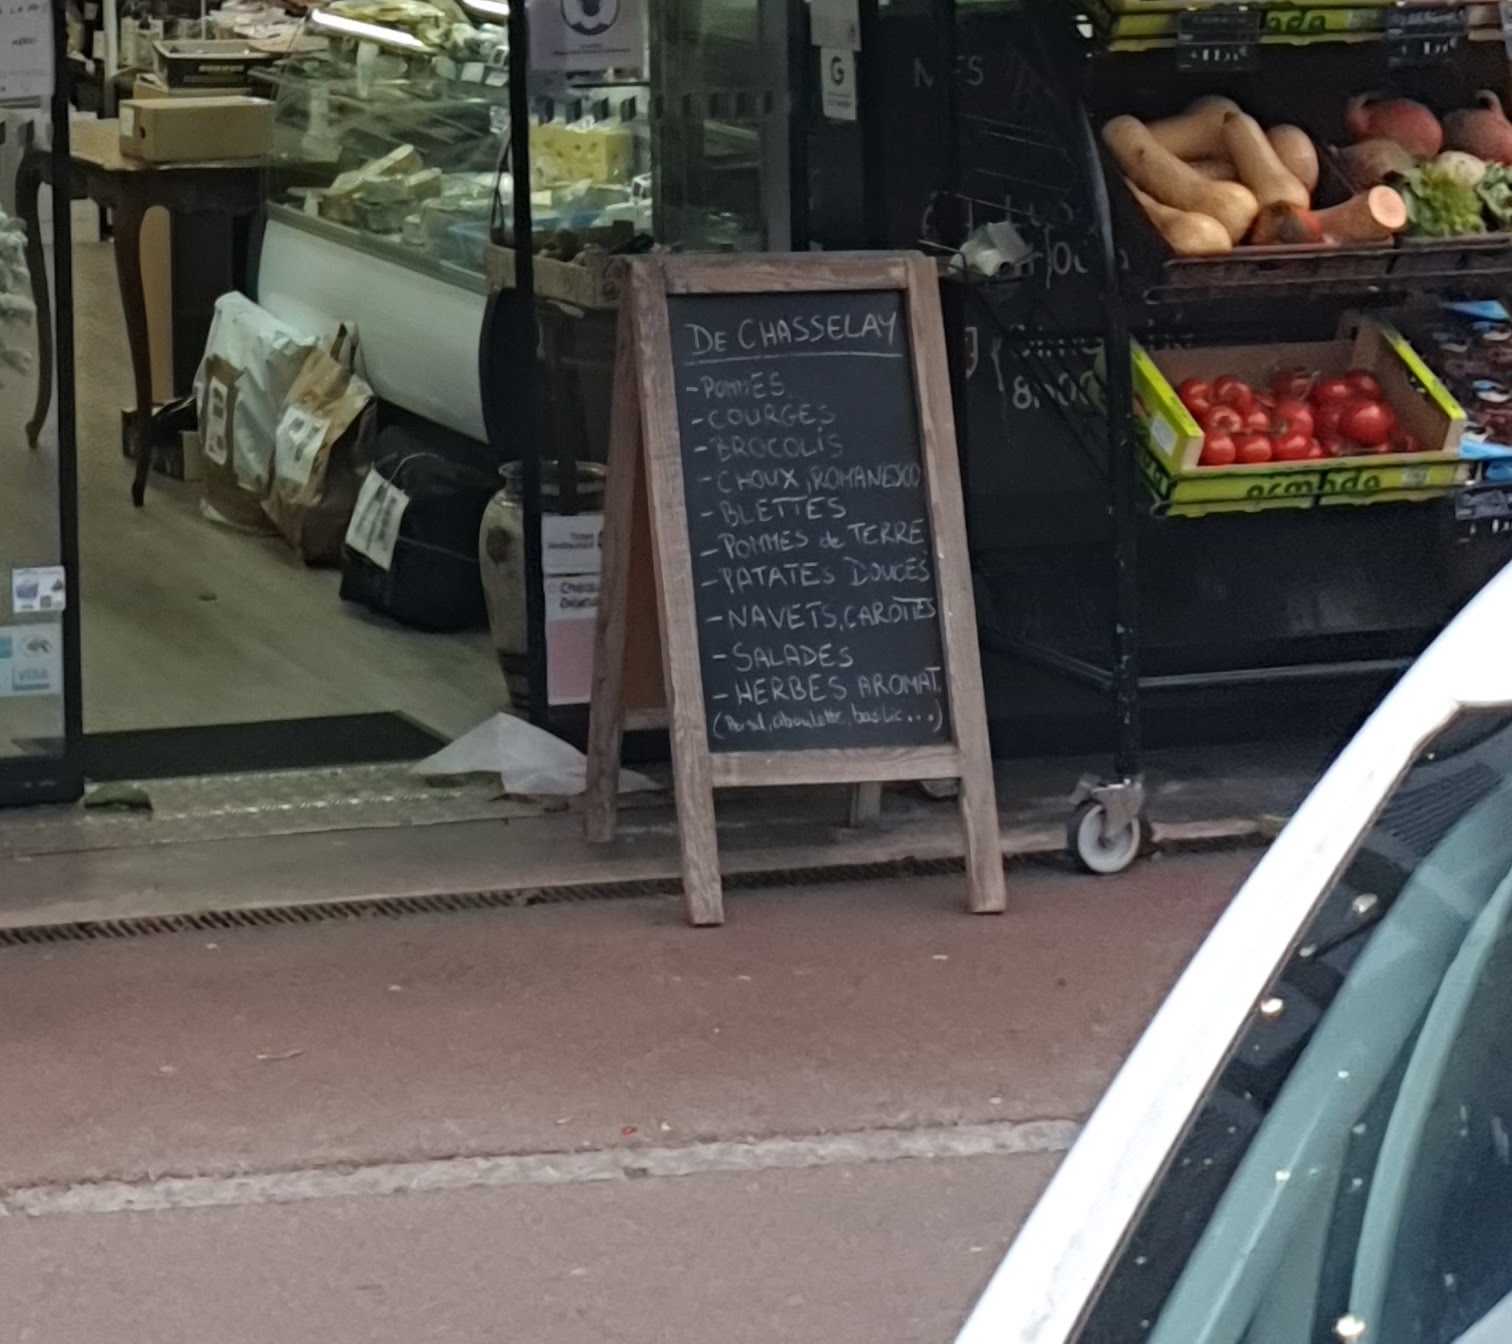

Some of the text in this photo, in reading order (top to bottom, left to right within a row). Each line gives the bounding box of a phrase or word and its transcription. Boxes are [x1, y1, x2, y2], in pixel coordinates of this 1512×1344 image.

[737, 312, 897, 350] CHASSELAY
[707, 403, 835, 430] COURGES
[718, 495, 847, 527] BLETTES
[717, 530, 809, 559] POMMES
[848, 518, 925, 546] TERRE
[720, 556, 931, 594] PATATES DOUCES
[732, 641, 854, 673] SALADES
[734, 673, 847, 706] HERBES
